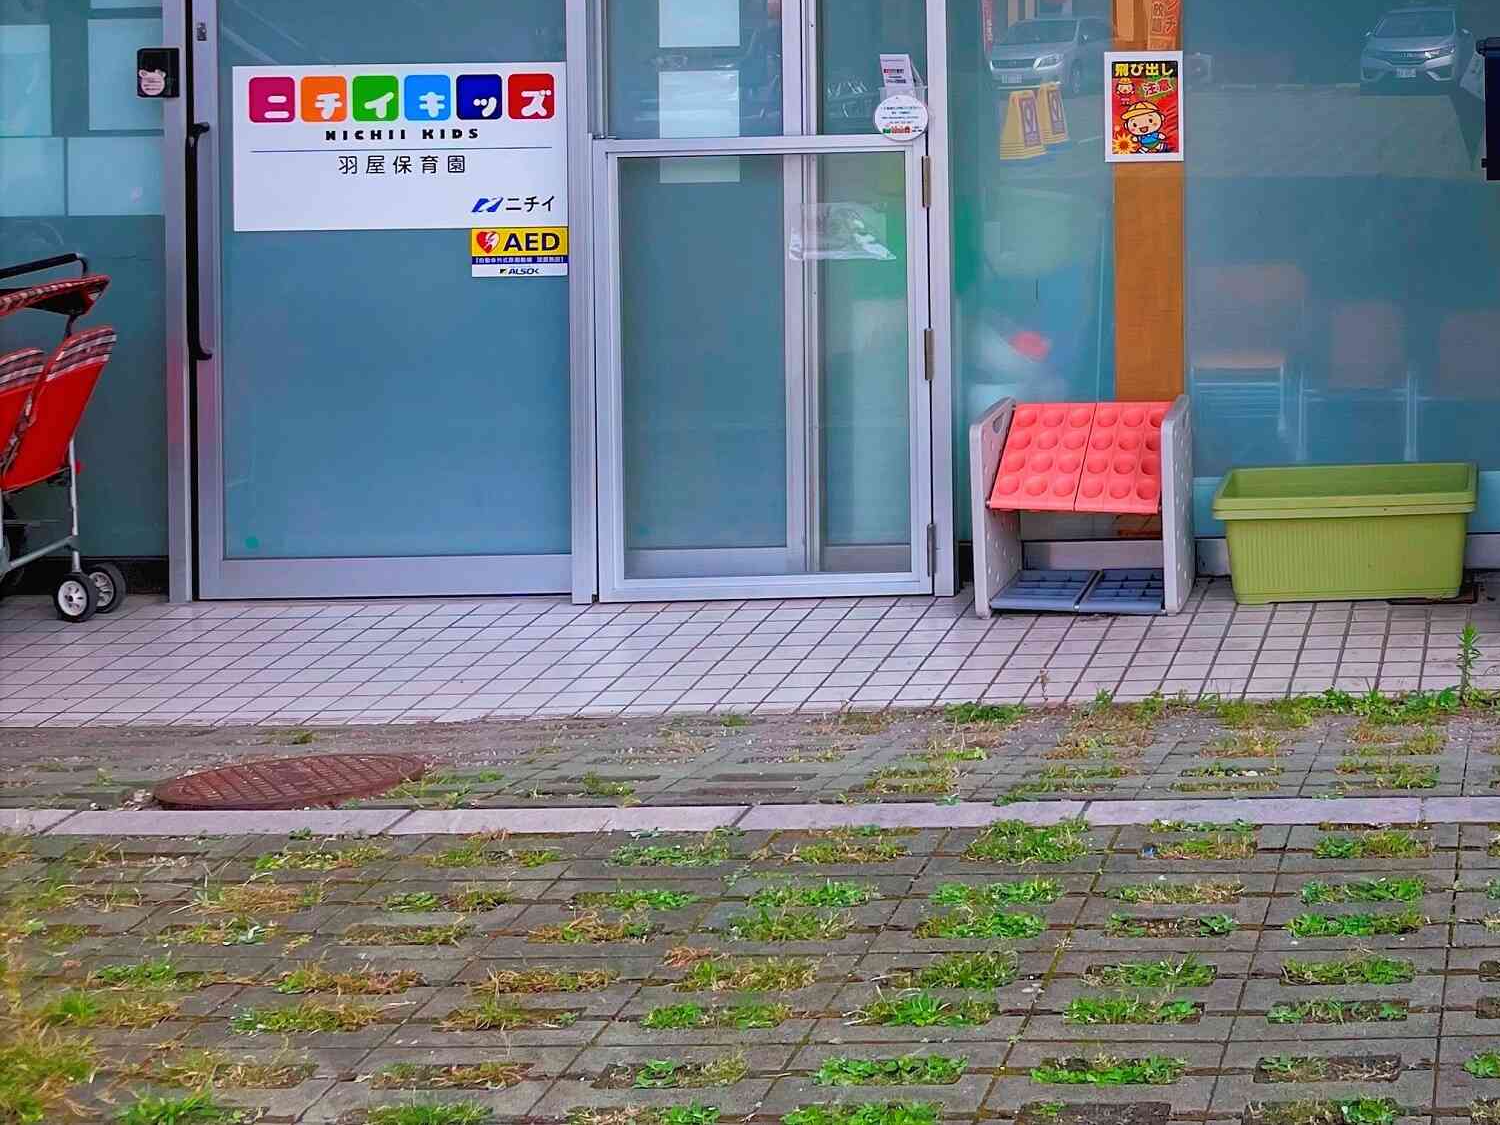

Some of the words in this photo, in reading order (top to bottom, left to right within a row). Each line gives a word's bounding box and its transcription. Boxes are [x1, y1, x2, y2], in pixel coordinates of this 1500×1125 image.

[1114, 62, 1175, 78] 飛び出し
[262, 87, 553, 121] ニチイキッズ
[324, 128, 407, 142] NICHII
[421, 127, 479, 141] KIDS
[337, 154, 467, 175] 羽屋保育園
[504, 194, 556, 213] ニチイ
[502, 232, 561, 252] AED
[507, 267, 541, 276] ALSOK
